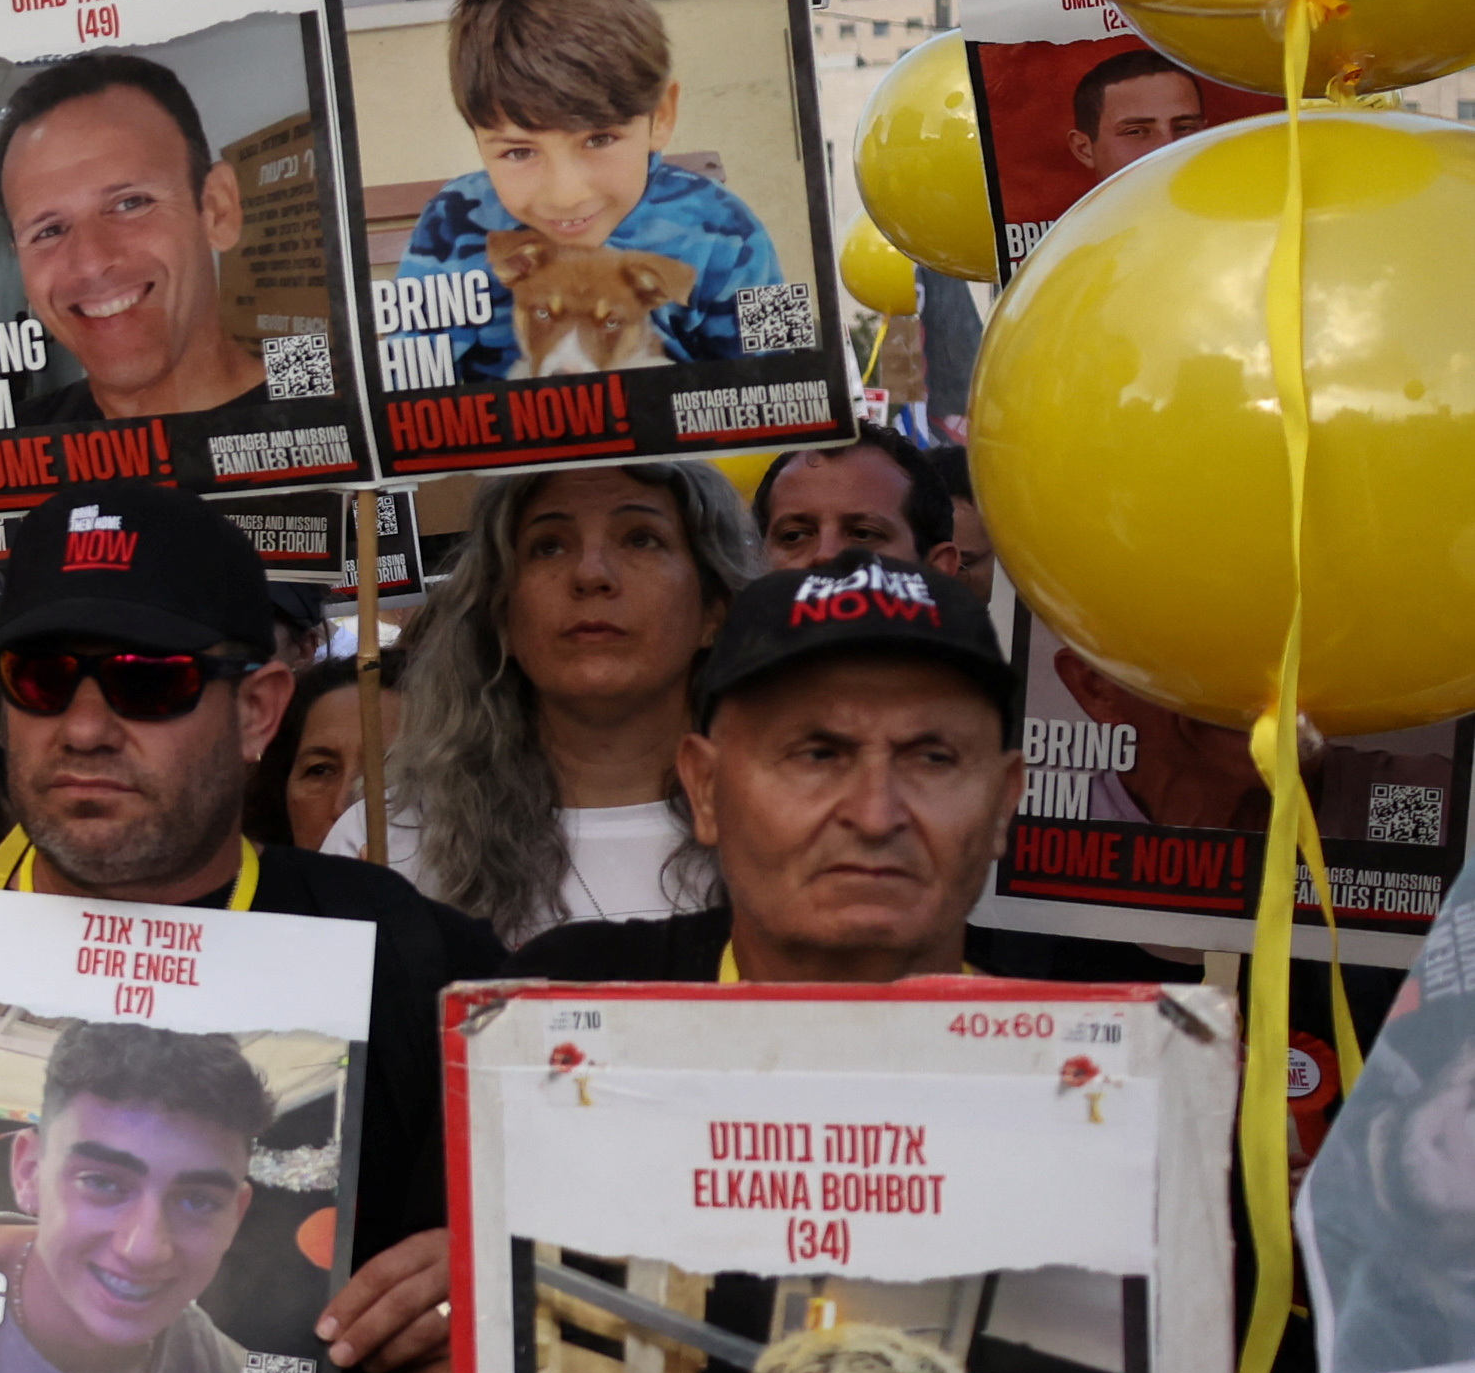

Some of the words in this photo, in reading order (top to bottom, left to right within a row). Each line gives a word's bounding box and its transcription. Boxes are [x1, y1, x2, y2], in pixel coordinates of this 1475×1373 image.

[76, 3, 121, 44] (49)
[373, 270, 492, 335] BRING
[378, 332, 455, 393] HIM
[387, 388, 505, 453] HOME
[510, 372, 629, 441] NOW!
[66, 530, 139, 563] NOW
[1022, 718, 1137, 773] BRING
[1019, 769, 1092, 822] HIM
[1012, 826, 1125, 879] HOME
[1131, 833, 1247, 892] NOW!
[948, 1013, 1055, 1040] 40x60
[709, 1121, 813, 1166] בוחבוט
[823, 1123, 926, 1168] אלקנה
[693, 1167, 810, 1211] ELKANA
[821, 1173, 944, 1216] BOHBOT
[786, 1218, 851, 1265] (34)
